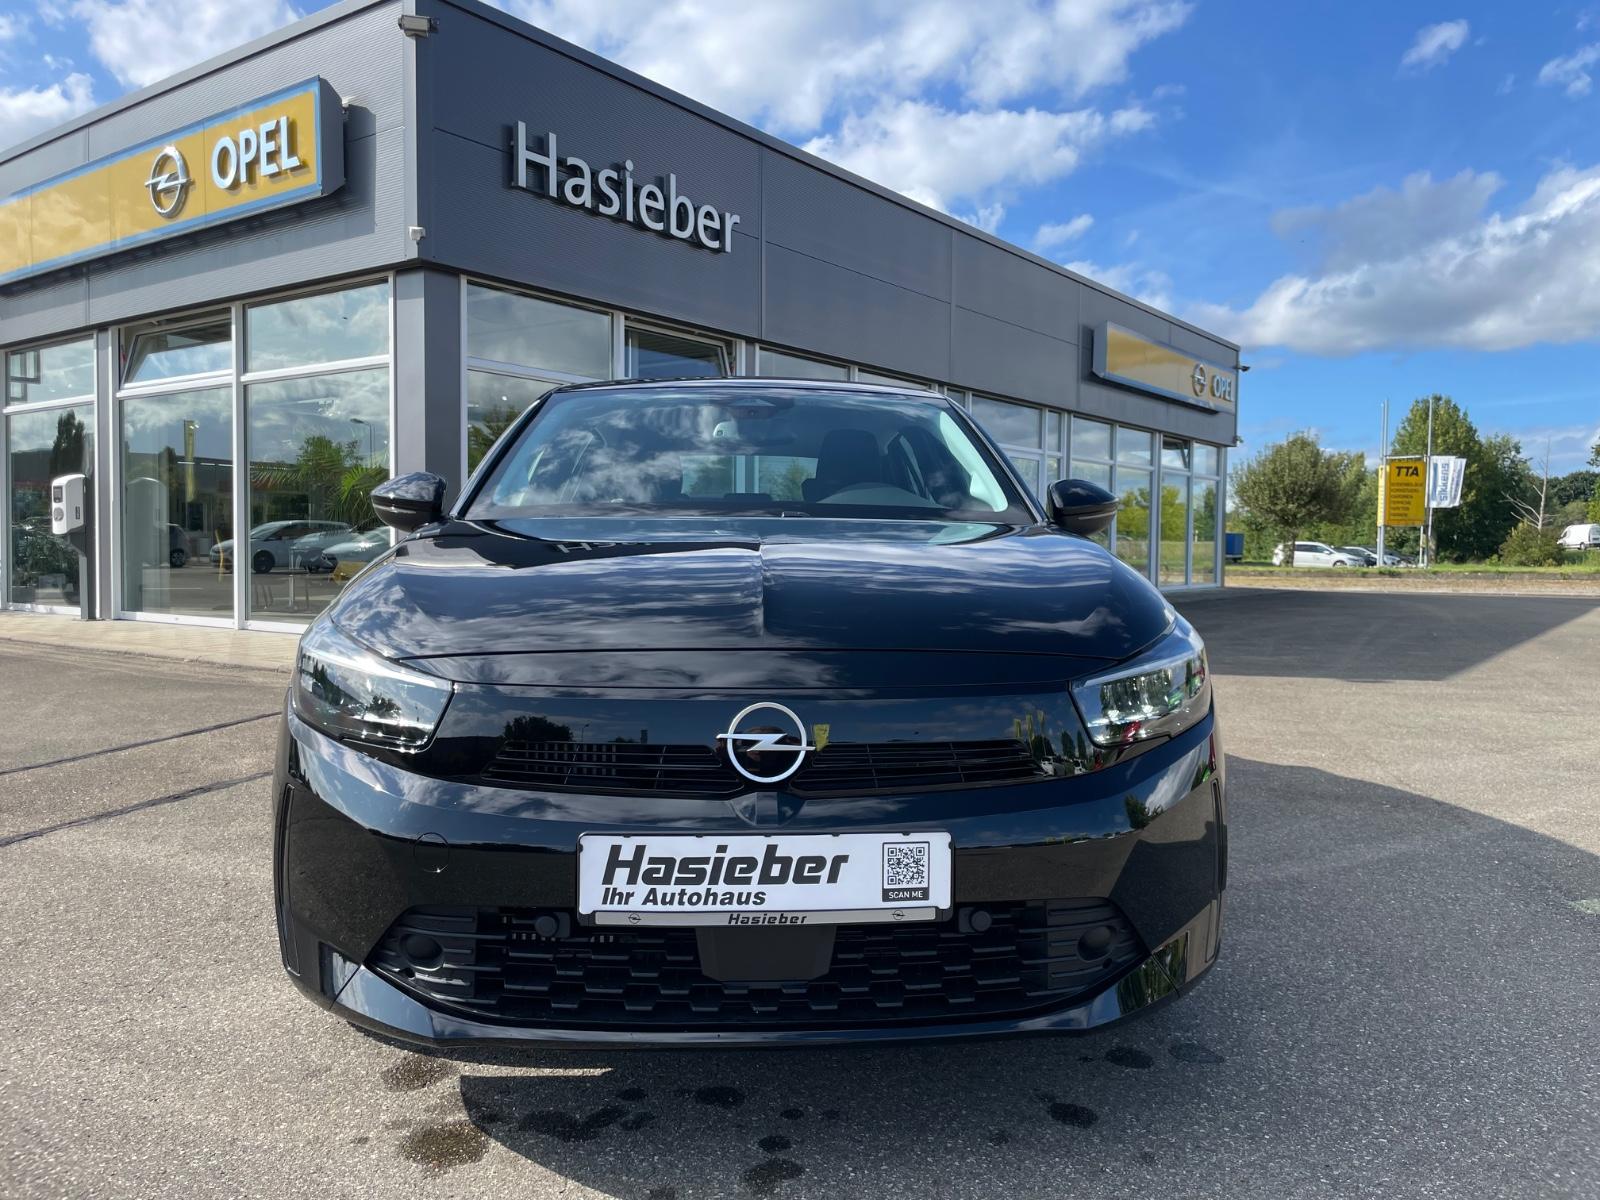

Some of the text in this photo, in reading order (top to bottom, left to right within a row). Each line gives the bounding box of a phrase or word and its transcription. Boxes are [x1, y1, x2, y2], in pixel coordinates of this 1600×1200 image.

[211, 115, 301, 189] OPEL
[514, 120, 740, 253] Hasieber
[1396, 466, 1419, 477] TTA
[602, 844, 849, 885] Hasieber
[602, 887, 766, 906] Ihr Autohaus
[888, 890, 923, 899] SCAN ME
[728, 913, 807, 925] Hasieber
